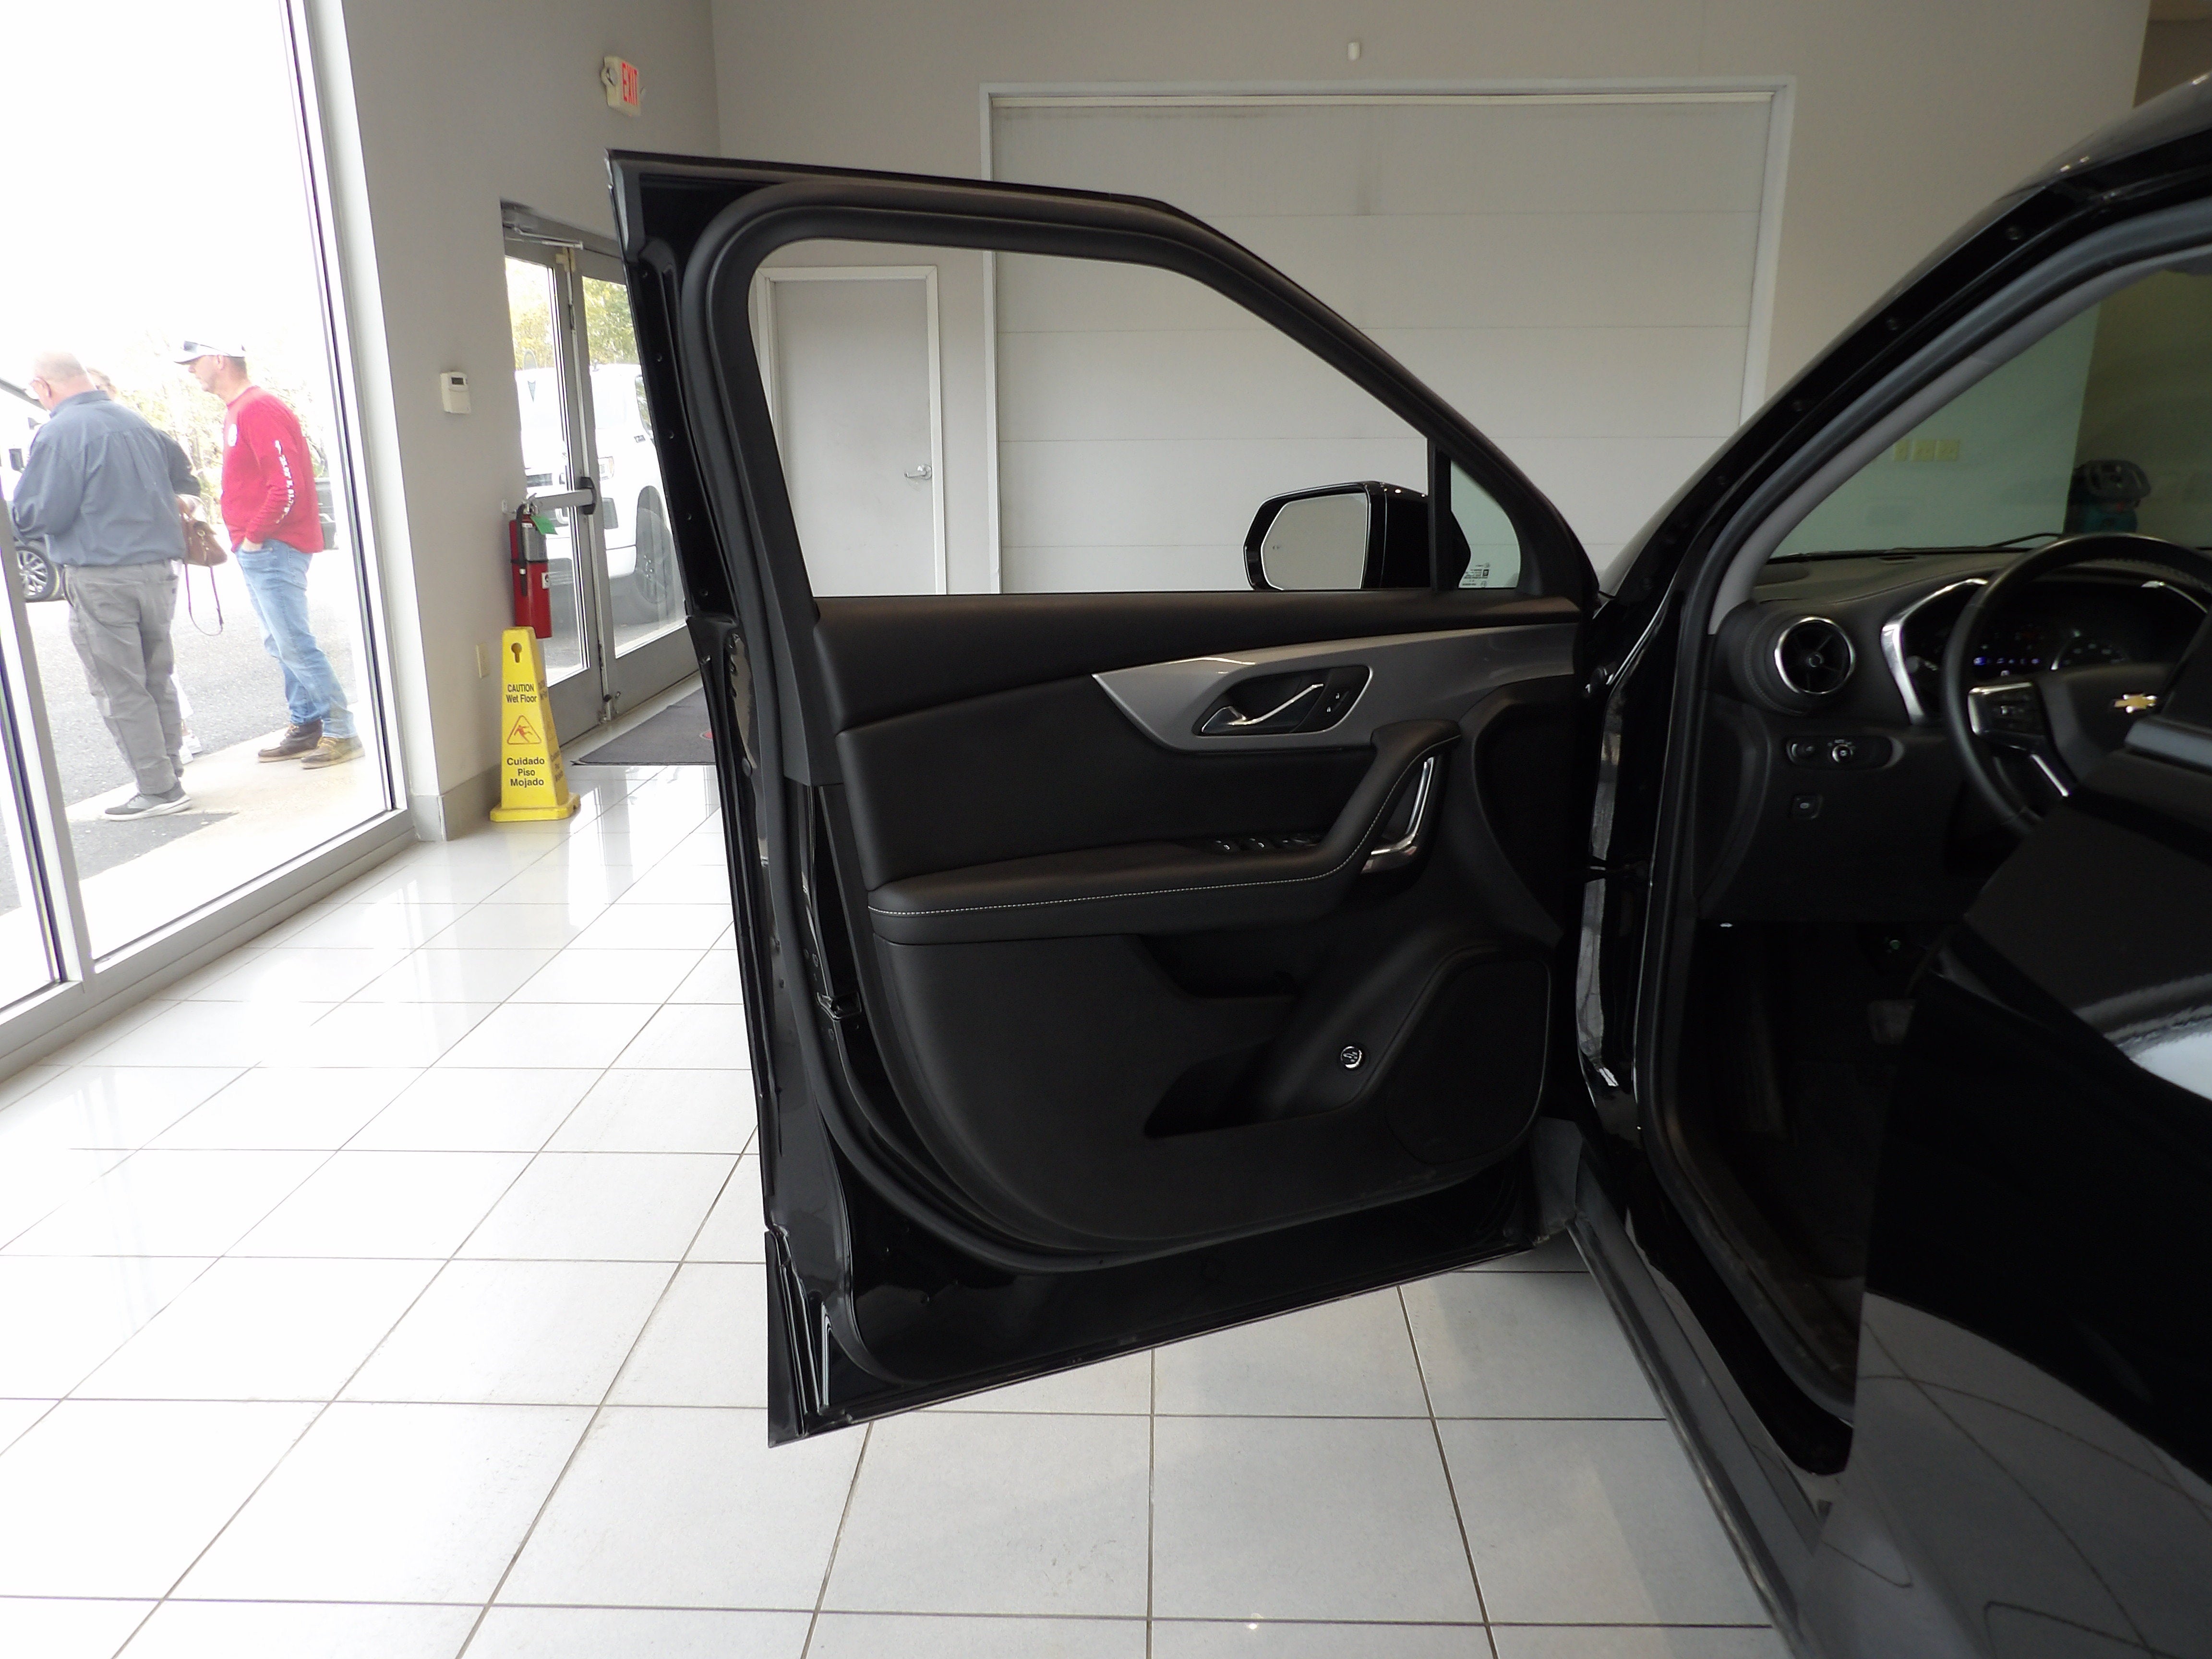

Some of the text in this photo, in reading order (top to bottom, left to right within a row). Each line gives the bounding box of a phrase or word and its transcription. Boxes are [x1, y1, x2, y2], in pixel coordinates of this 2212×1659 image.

[507, 684, 534, 692] CAUTION
[506, 695, 518, 703] Wet
[520, 694, 537, 703] Floor
[507, 757, 545, 765] Cuidado
[510, 778, 544, 788] Mojado
